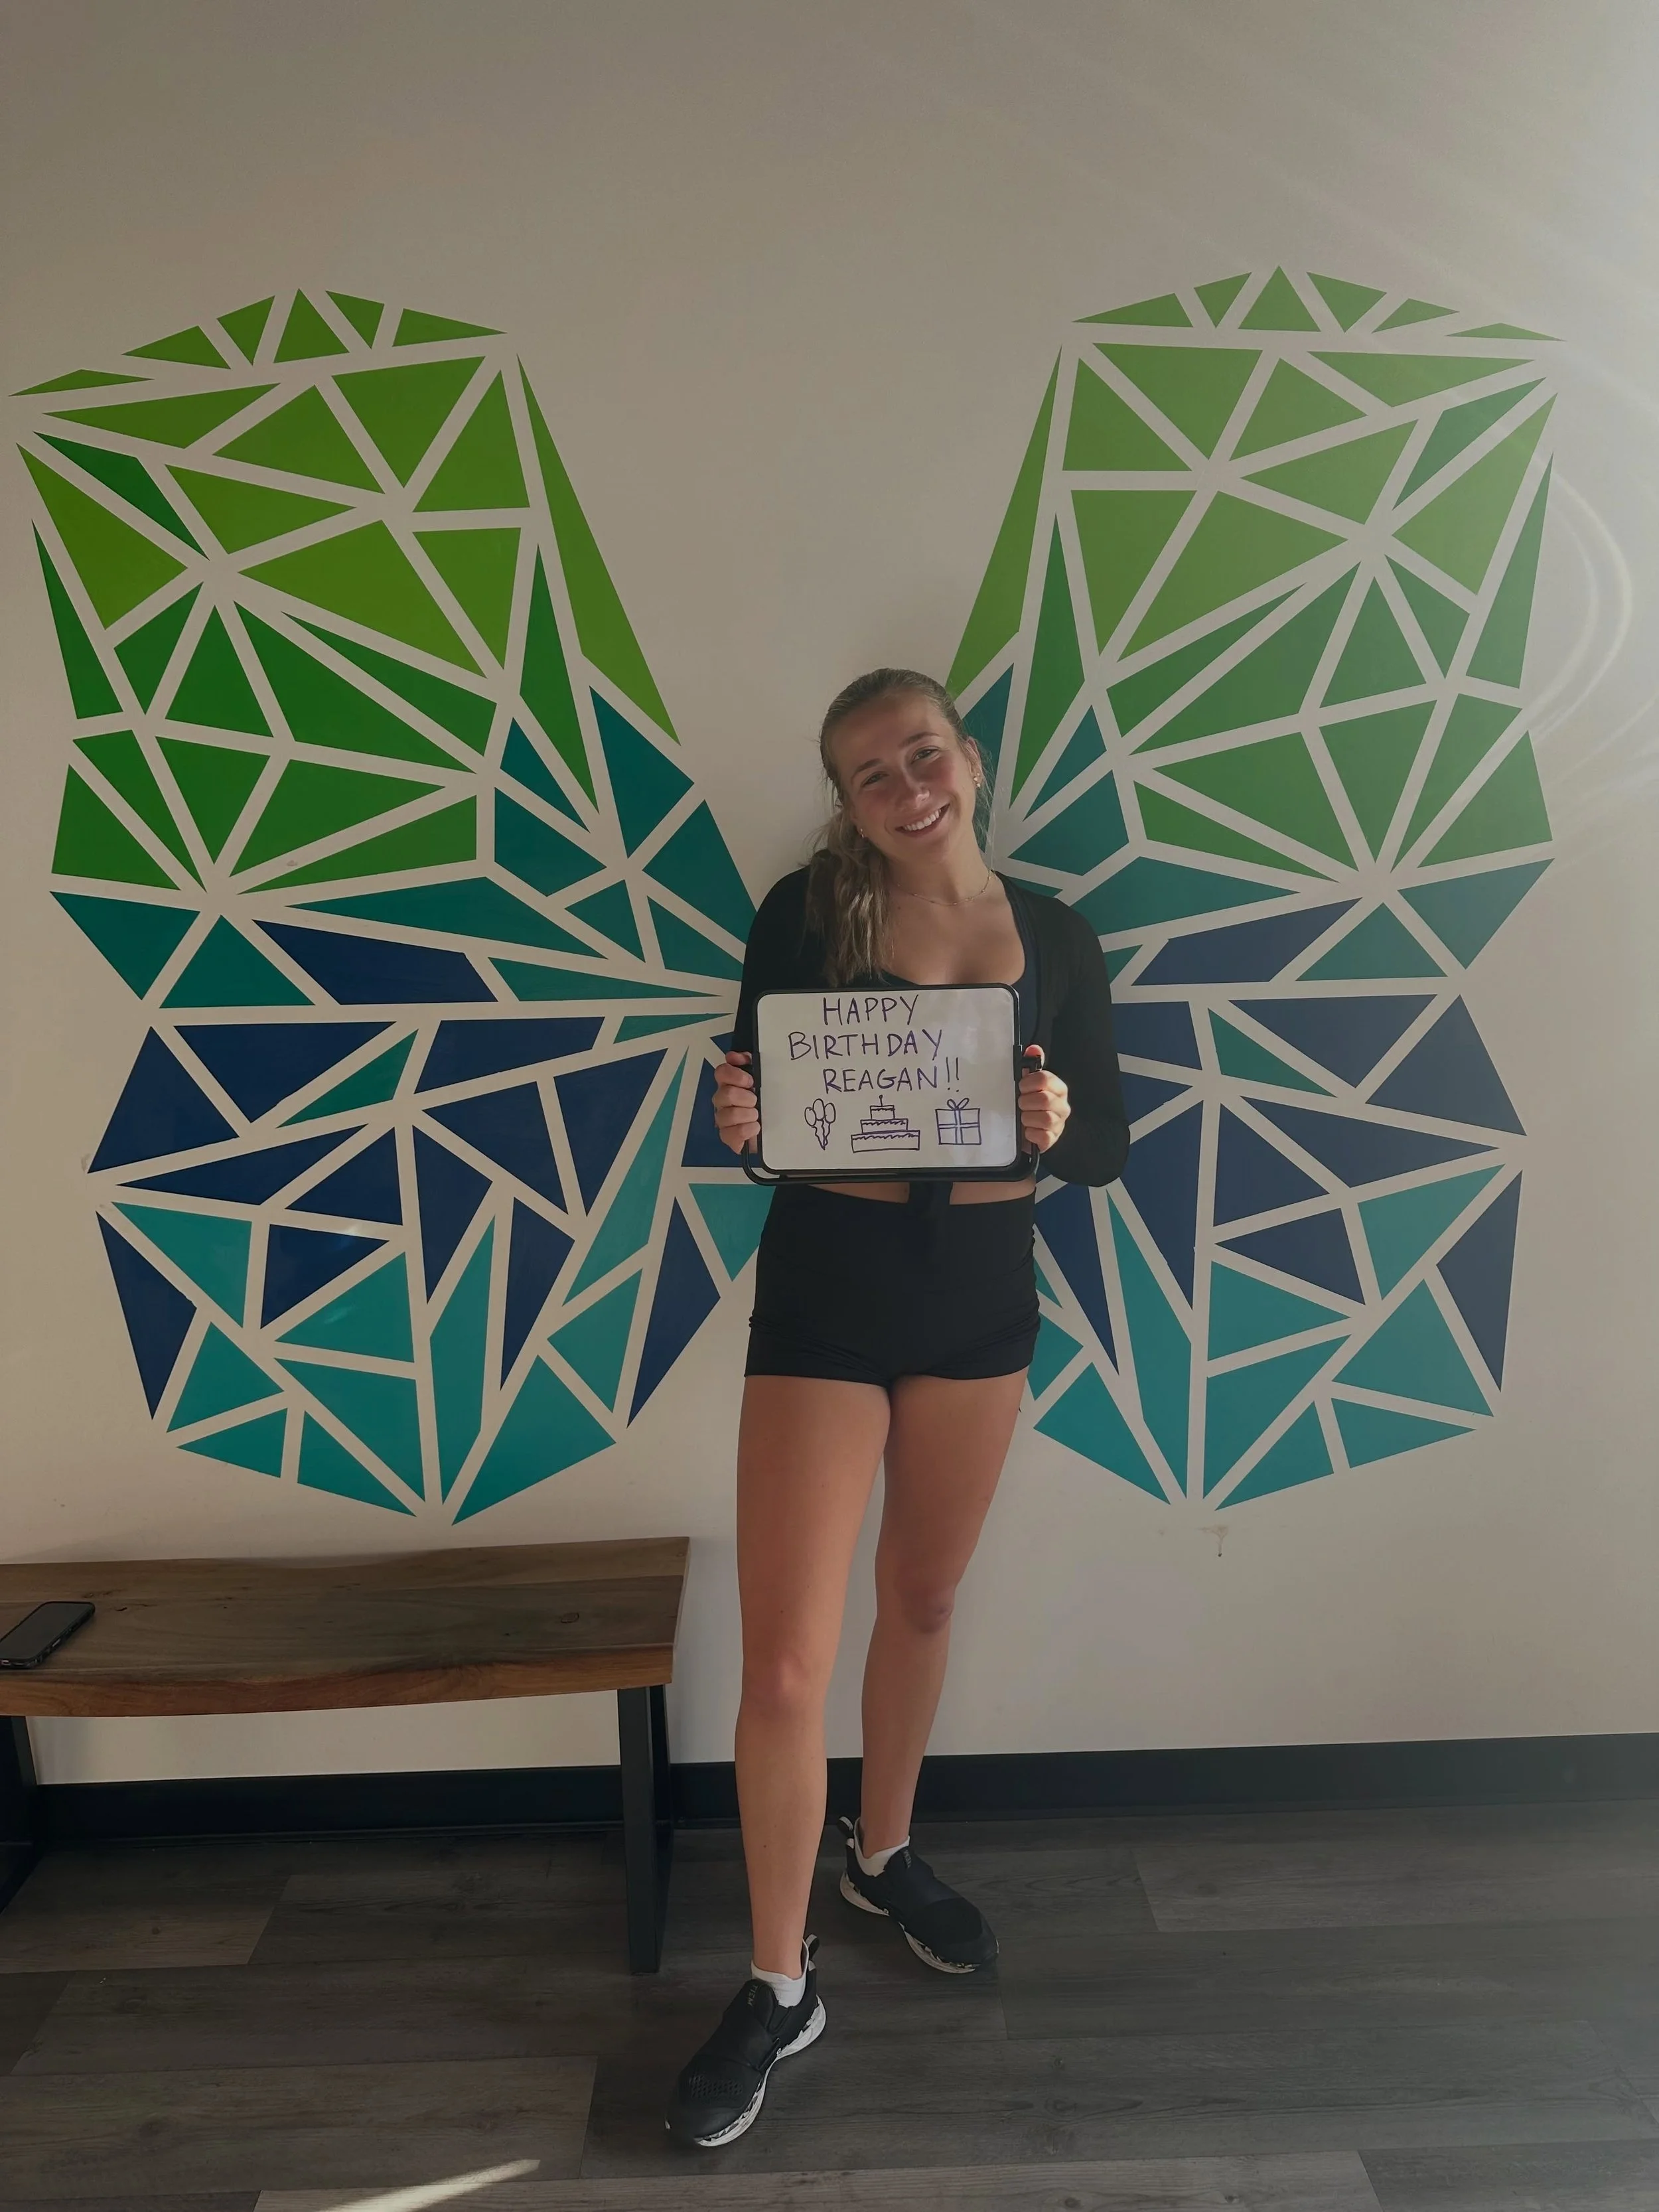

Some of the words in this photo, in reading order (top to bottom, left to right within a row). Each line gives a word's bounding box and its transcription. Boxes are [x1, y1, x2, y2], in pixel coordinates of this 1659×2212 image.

[823, 994, 919, 1025] HAPPY
[788, 1029, 942, 1061] BIRTHDAY
[823, 1057, 960, 1094] REAGAN!!
